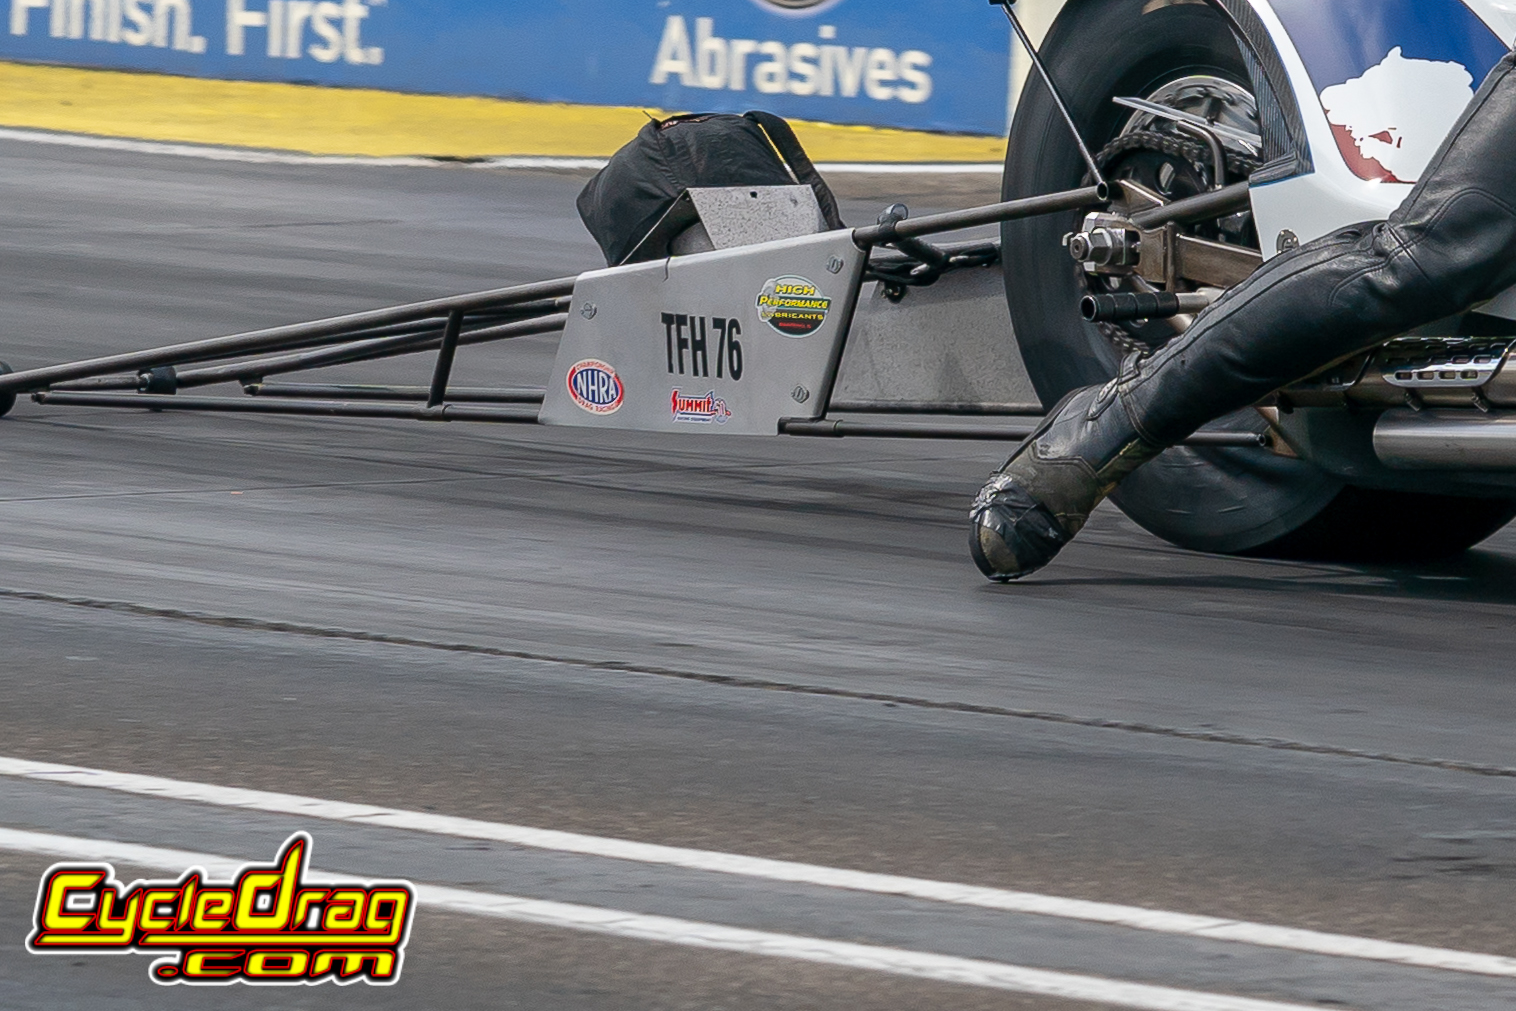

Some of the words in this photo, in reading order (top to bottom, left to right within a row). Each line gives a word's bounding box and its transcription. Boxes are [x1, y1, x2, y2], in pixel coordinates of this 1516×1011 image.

[649, 15, 933, 103] Abrasives
[775, 284, 816, 296] HIGH
[661, 312, 709, 378] TFH
[712, 317, 743, 381] 76
[577, 370, 617, 403] NHRA
